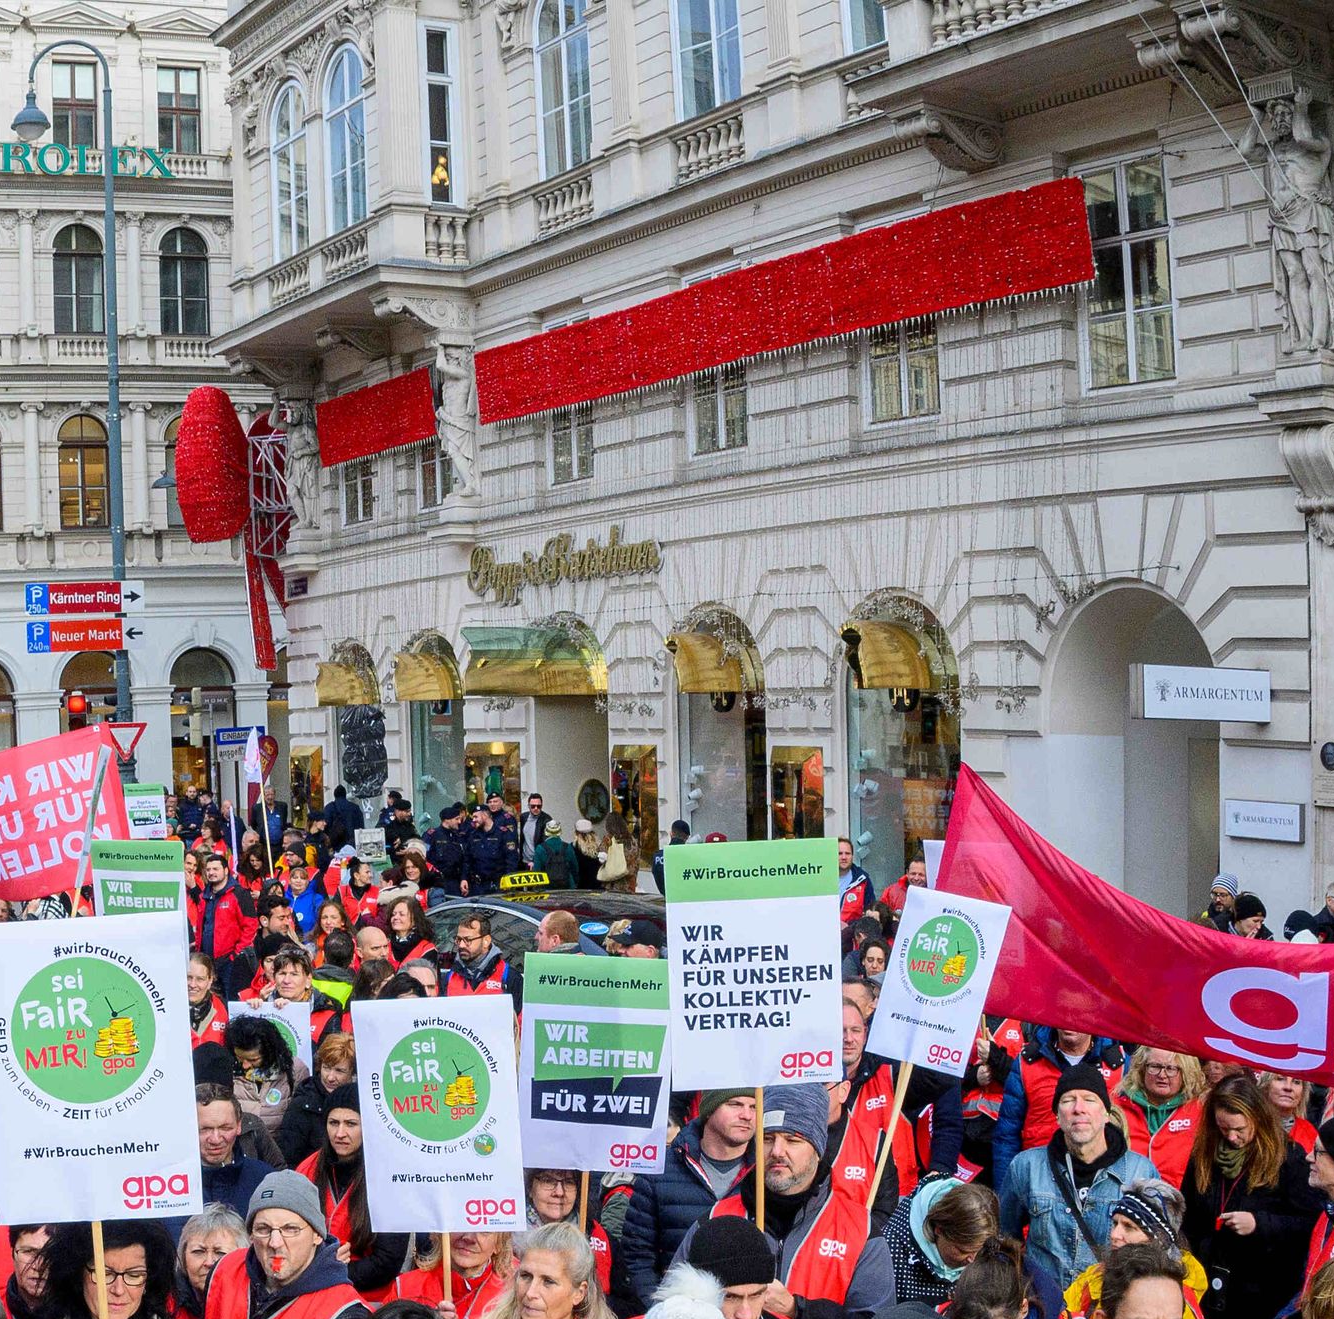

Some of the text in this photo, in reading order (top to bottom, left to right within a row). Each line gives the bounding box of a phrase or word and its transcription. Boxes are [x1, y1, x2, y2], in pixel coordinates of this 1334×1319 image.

[0, 142, 176, 179] ROLEX
[49, 590, 121, 605] Kärntner Ring
[51, 628, 121, 642] Neuer Markt
[1173, 686, 1264, 702] ARMARGENTUM
[1242, 815, 1294, 826] ARMARGENTUM
[99, 852, 174, 861] #WirBrauchenMehr
[513, 874, 540, 885] TAXI
[682, 863, 823, 881] #WirBrauchenMehr
[106, 881, 133, 894] WIR
[108, 896, 175, 909] ARBEITEN
[681, 924, 724, 943] WIR
[935, 921, 952, 935] sei
[682, 941, 789, 966] KÄMPFEN
[916, 933, 949, 957] FaiR
[51, 968, 83, 992] sei
[53, 942, 166, 1014] #wirbrauchenmehr
[538, 974, 663, 991] #WirBrauchenMehr
[683, 964, 834, 988] FÜR UNSEREN
[683, 988, 811, 1010] KOLLEKTIV-
[20, 997, 93, 1030] FaiR
[684, 1010, 792, 1031] VERTRAG!
[890, 1012, 956, 1035] #WirBrauchenMehr
[66, 1028, 86, 1041] zu
[544, 1024, 589, 1043] WIR
[411, 1036, 436, 1055] sei
[412, 1016, 499, 1075] #wirbrauchenmehr
[927, 1042, 963, 1067] gpa
[25, 1043, 88, 1072] MIR!
[103, 1056, 136, 1075] gpa
[541, 1046, 654, 1070] ARBEITEN
[780, 1050, 833, 1079] gpa
[388, 1059, 444, 1084] FaiR
[17, 1080, 52, 1113] Leben
[63, 1107, 92, 1120] ZEIT
[95, 1105, 113, 1120] für
[115, 1067, 165, 1113] Erholung
[423, 1084, 438, 1093] zu
[392, 1094, 440, 1116] MIR!
[541, 1089, 650, 1115] FÜR ZWEI
[866, 1094, 887, 1112] gpa
[371, 1072, 441, 1155] GELD Leben ZEIT
[450, 1106, 475, 1120] gpa
[1168, 1118, 1192, 1132] gpa
[24, 1142, 160, 1160] #WirBrauchenMehr
[609, 1143, 658, 1169] gpa
[391, 1172, 494, 1183] #WirBrauchenMehr
[122, 1173, 190, 1210] gpa
[465, 1198, 516, 1225] gpa
